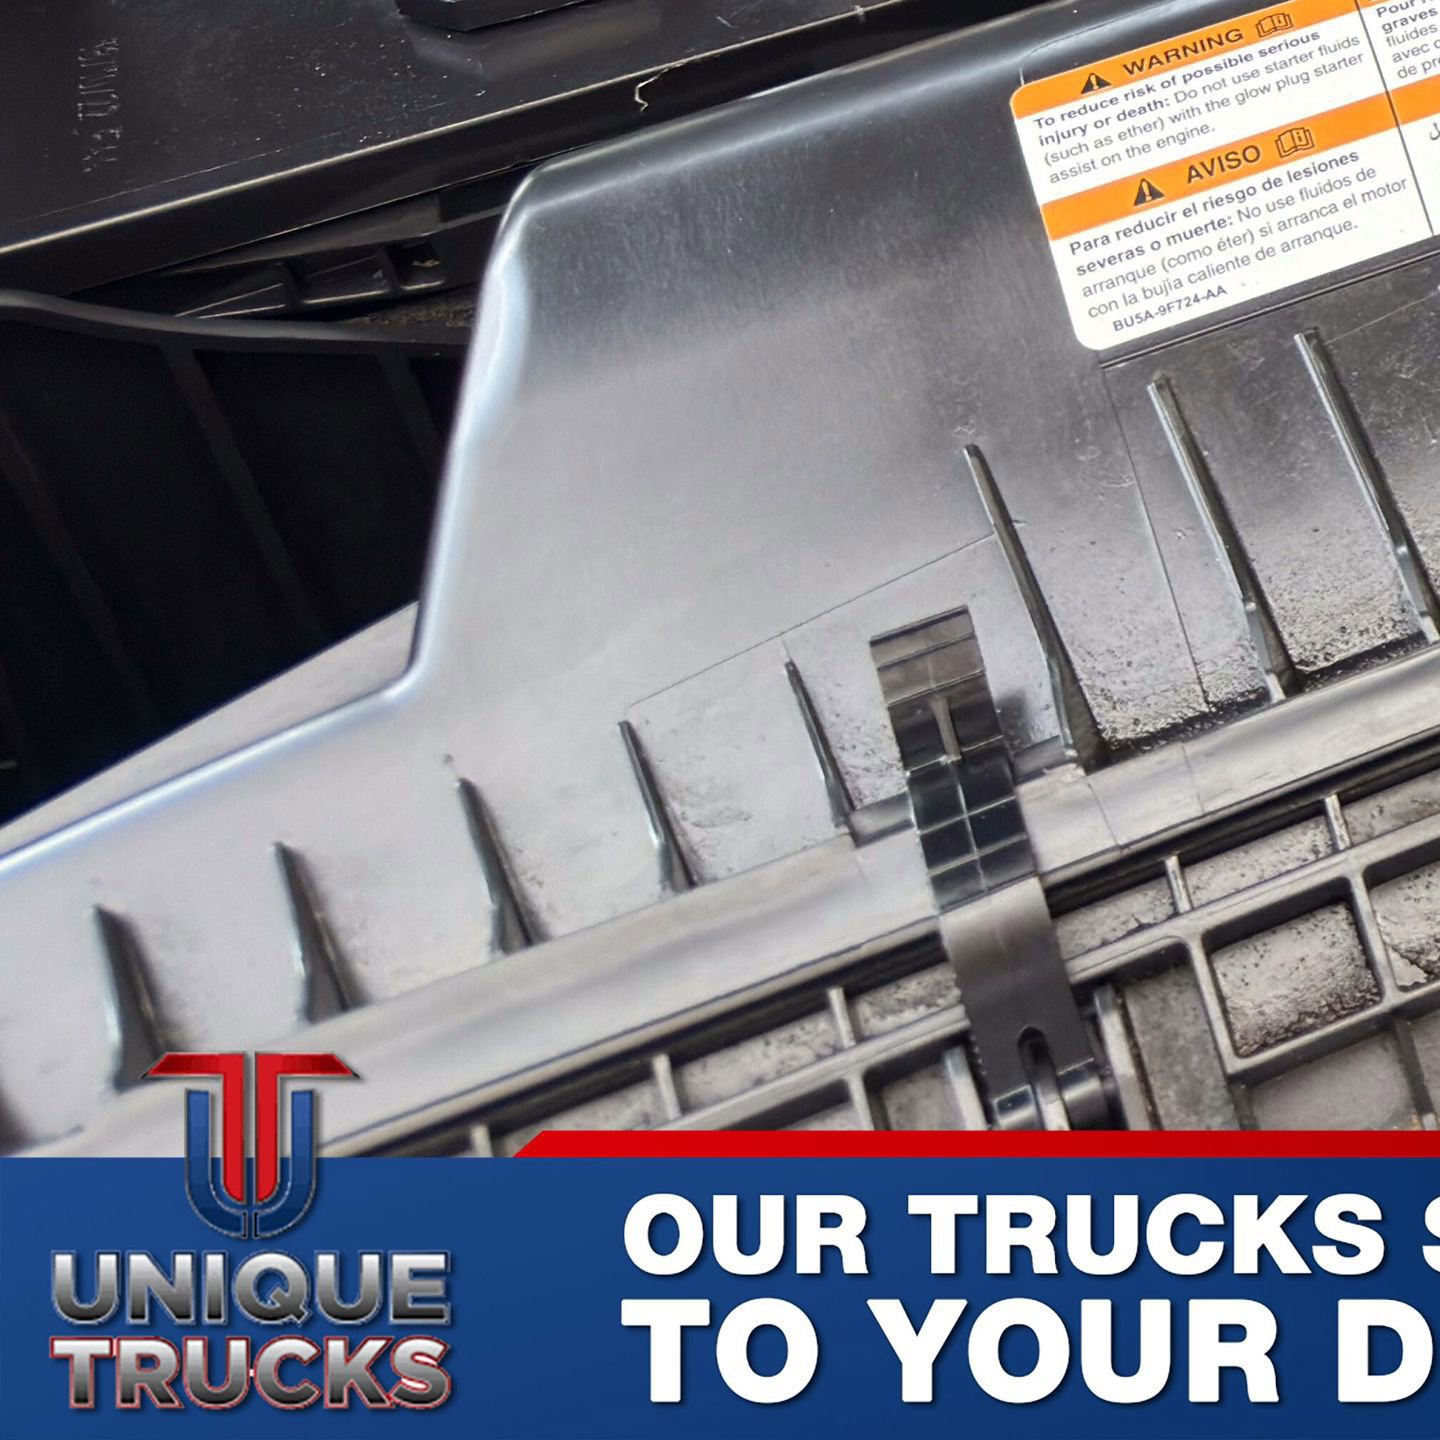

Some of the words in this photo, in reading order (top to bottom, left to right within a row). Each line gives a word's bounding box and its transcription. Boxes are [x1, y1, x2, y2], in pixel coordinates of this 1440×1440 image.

[1379, 3, 1438, 33] graves
[1384, 19, 1439, 48] fluides
[1389, 39, 1429, 63] avec
[1033, 113, 1055, 131] To
[1059, 92, 1120, 123] reduce
[1122, 81, 1156, 103] risk
[1159, 74, 1178, 91] of
[1181, 50, 1254, 84] possible
[1256, 29, 1321, 60] serious
[1121, 26, 1244, 77] WARNING
[1395, 61, 1418, 80] de
[1037, 121, 1089, 149] injury
[1093, 115, 1111, 130] or
[1114, 95, 1171, 123] death:
[1173, 85, 1198, 104] Do
[1200, 76, 1228, 95] not
[1230, 67, 1261, 86] use
[1263, 48, 1314, 75] starter
[1317, 33, 1361, 57] fluids
[1042, 139, 1090, 167] (such
[1093, 134, 1113, 150] as
[1116, 115, 1165, 144] ether)
[1167, 103, 1202, 126] with
[1204, 94, 1231, 113] the
[1233, 81, 1272, 105] glow
[1274, 68, 1311, 92] plug
[1312, 51, 1365, 78] starter
[1047, 157, 1097, 185] assist
[1099, 149, 1122, 168] on
[1124, 140, 1152, 160] the
[1154, 119, 1217, 152] engine.
[1183, 143, 1263, 184] AVISO
[1068, 229, 1111, 256] Para
[1113, 208, 1177, 242] reducir
[1180, 201, 1199, 220] el
[1201, 182, 1258, 213] riesgo
[1260, 174, 1284, 194] de
[1286, 149, 1361, 185] lesiones
[1074, 241, 1145, 276] severas
[1148, 235, 1162, 252] o
[1164, 212, 1234, 247] muerte:
[1236, 203, 1262, 223] No
[1264, 192, 1296, 214] use
[1298, 173, 1353, 203] fluidos
[1354, 165, 1377, 185] de
[1080, 259, 1158, 299] arranque
[1159, 241, 1213, 272] (como
[1214, 227, 1255, 254] éter)
[1257, 221, 1274, 240] si
[1275, 200, 1340, 234] arranca
[1341, 194, 1359, 212] el
[1359, 177, 1410, 206] motor
[1086, 295, 1120, 320] con
[1121, 288, 1139, 308] la
[1141, 274, 1184, 302] bujía
[1185, 251, 1252, 287] caliente
[1253, 243, 1278, 265] de
[1278, 216, 1360, 256] arranque.
[1112, 283, 1228, 333] BU5A-9F724-AA
